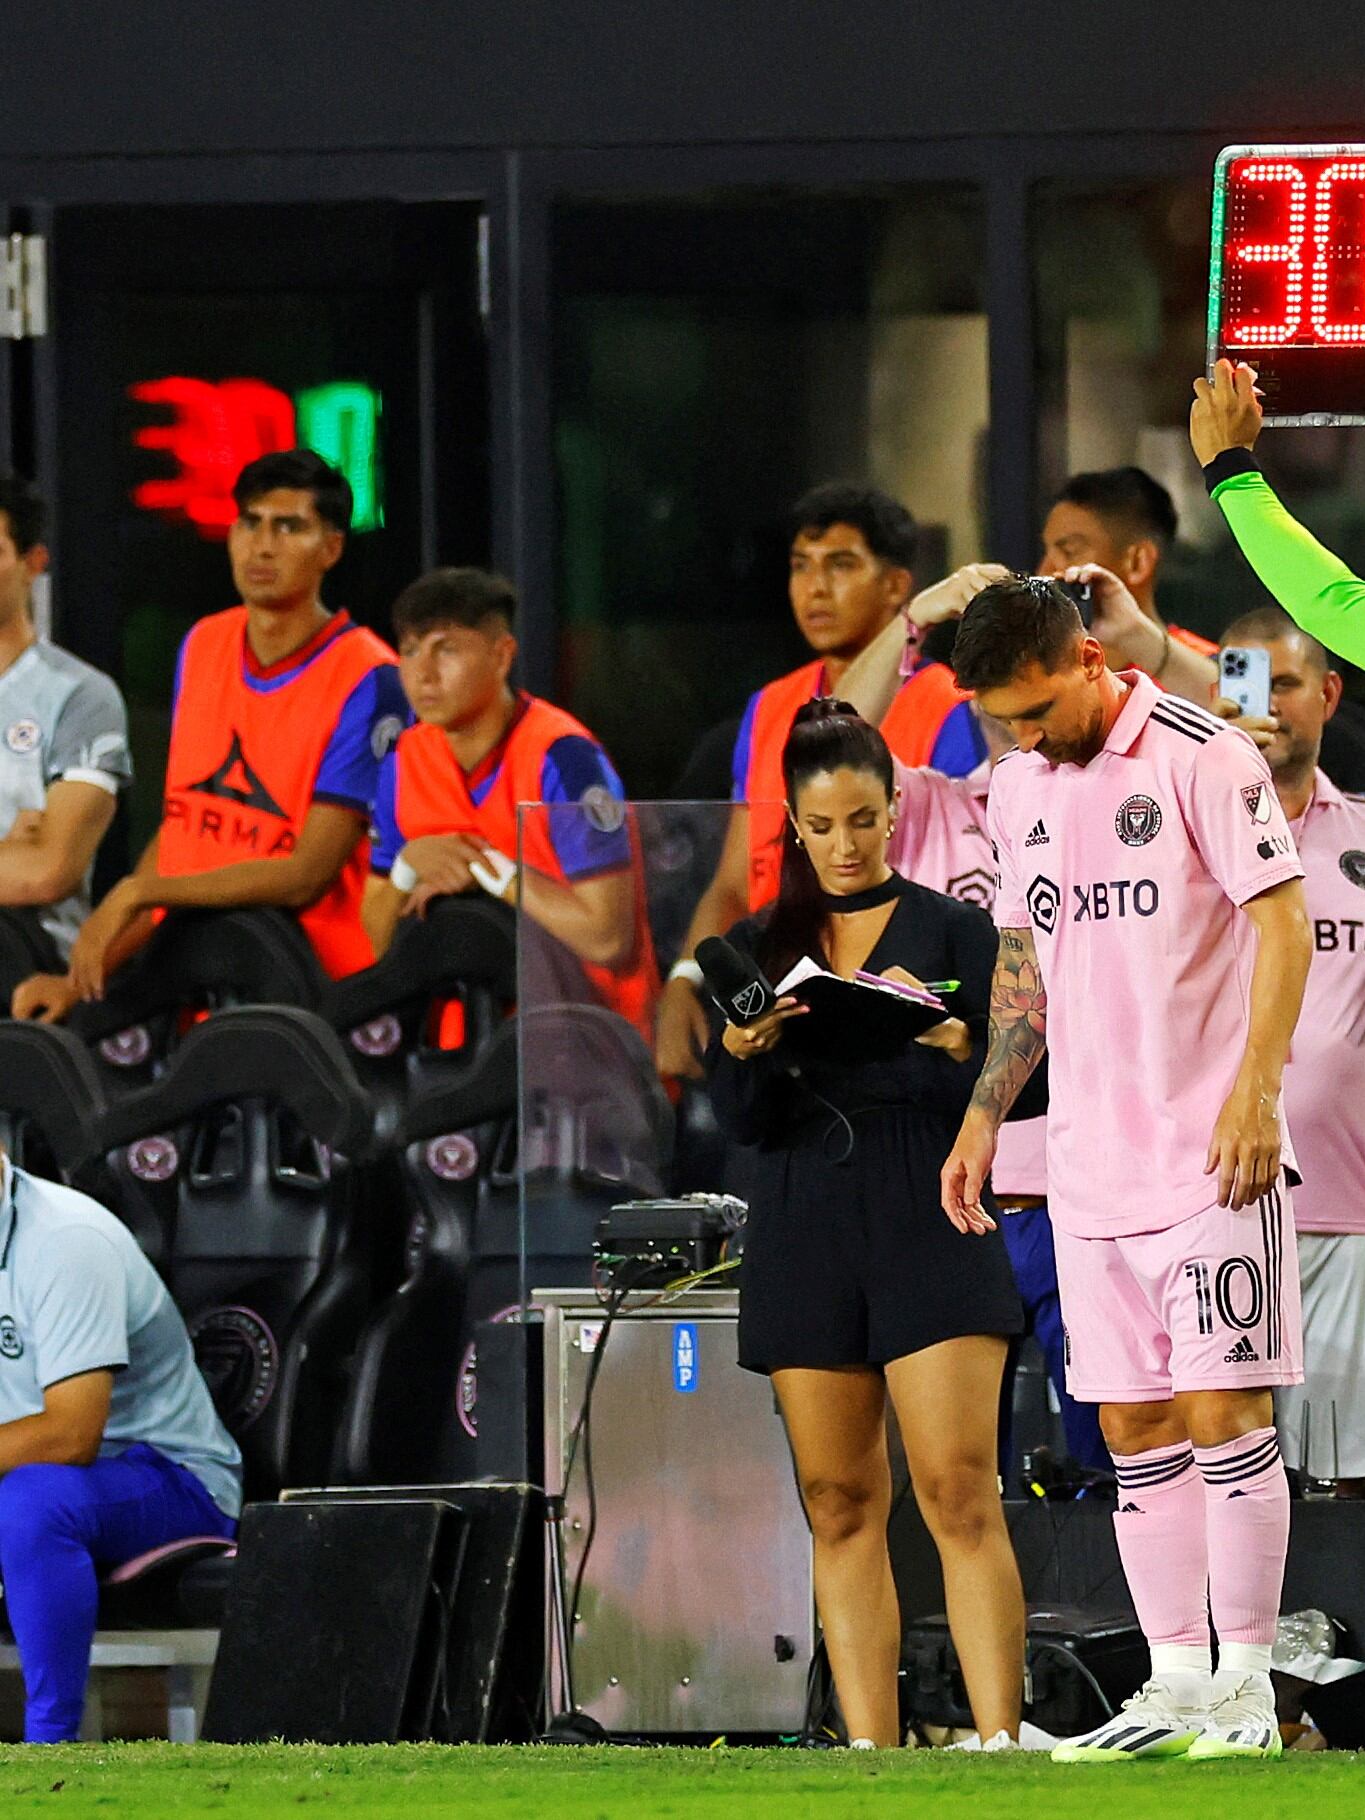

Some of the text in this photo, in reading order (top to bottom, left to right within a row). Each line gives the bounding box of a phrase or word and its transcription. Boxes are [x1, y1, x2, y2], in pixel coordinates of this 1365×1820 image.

[1025, 835, 1050, 848] adidas
[1073, 878, 1159, 922] XBTO
[1184, 1254, 1263, 1334] 10
[677, 1329, 694, 1387] AMP
[1224, 1352, 1259, 1363] adidas
